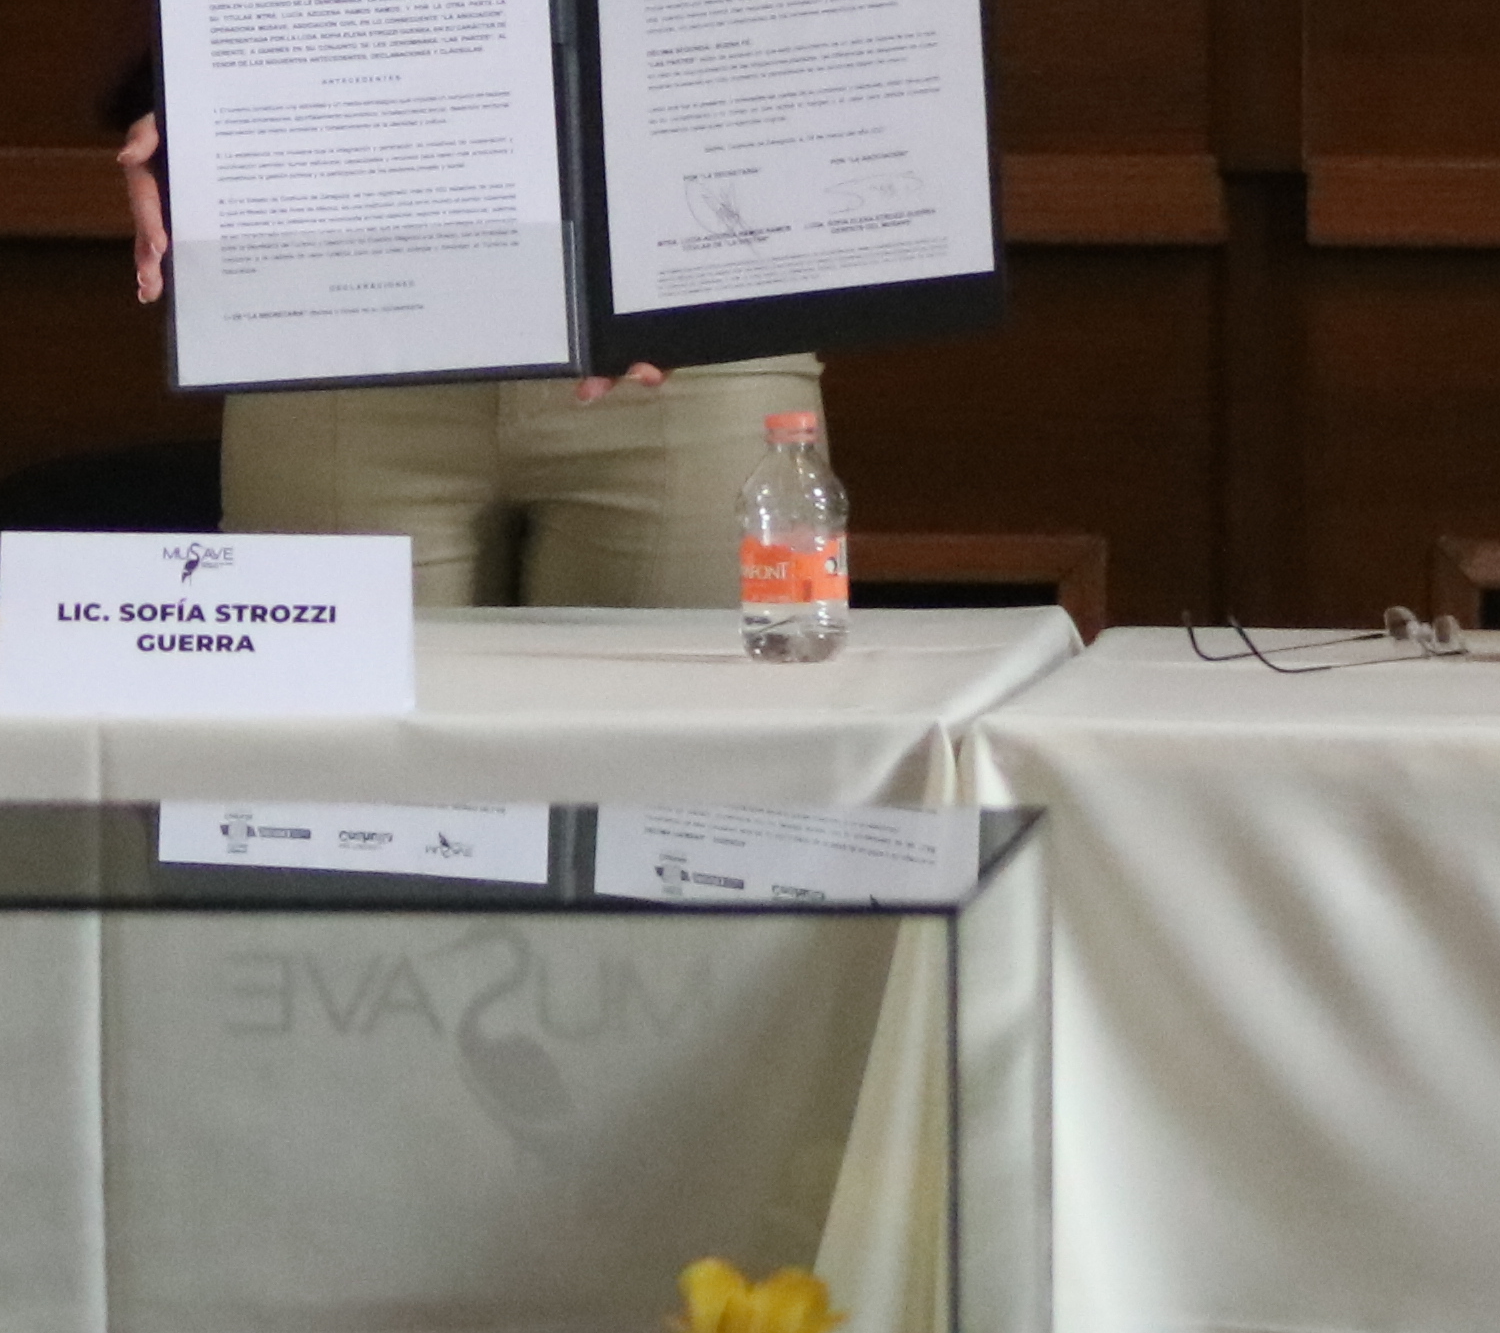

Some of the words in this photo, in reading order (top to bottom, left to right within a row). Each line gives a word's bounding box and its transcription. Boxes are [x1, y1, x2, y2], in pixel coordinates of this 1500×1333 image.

[163, 542, 235, 561] MUSAVE
[57, 603, 110, 622] LIC.
[119, 598, 206, 623] SOFÍA
[215, 604, 337, 623] STROZZI
[136, 634, 256, 653] GUERRA
